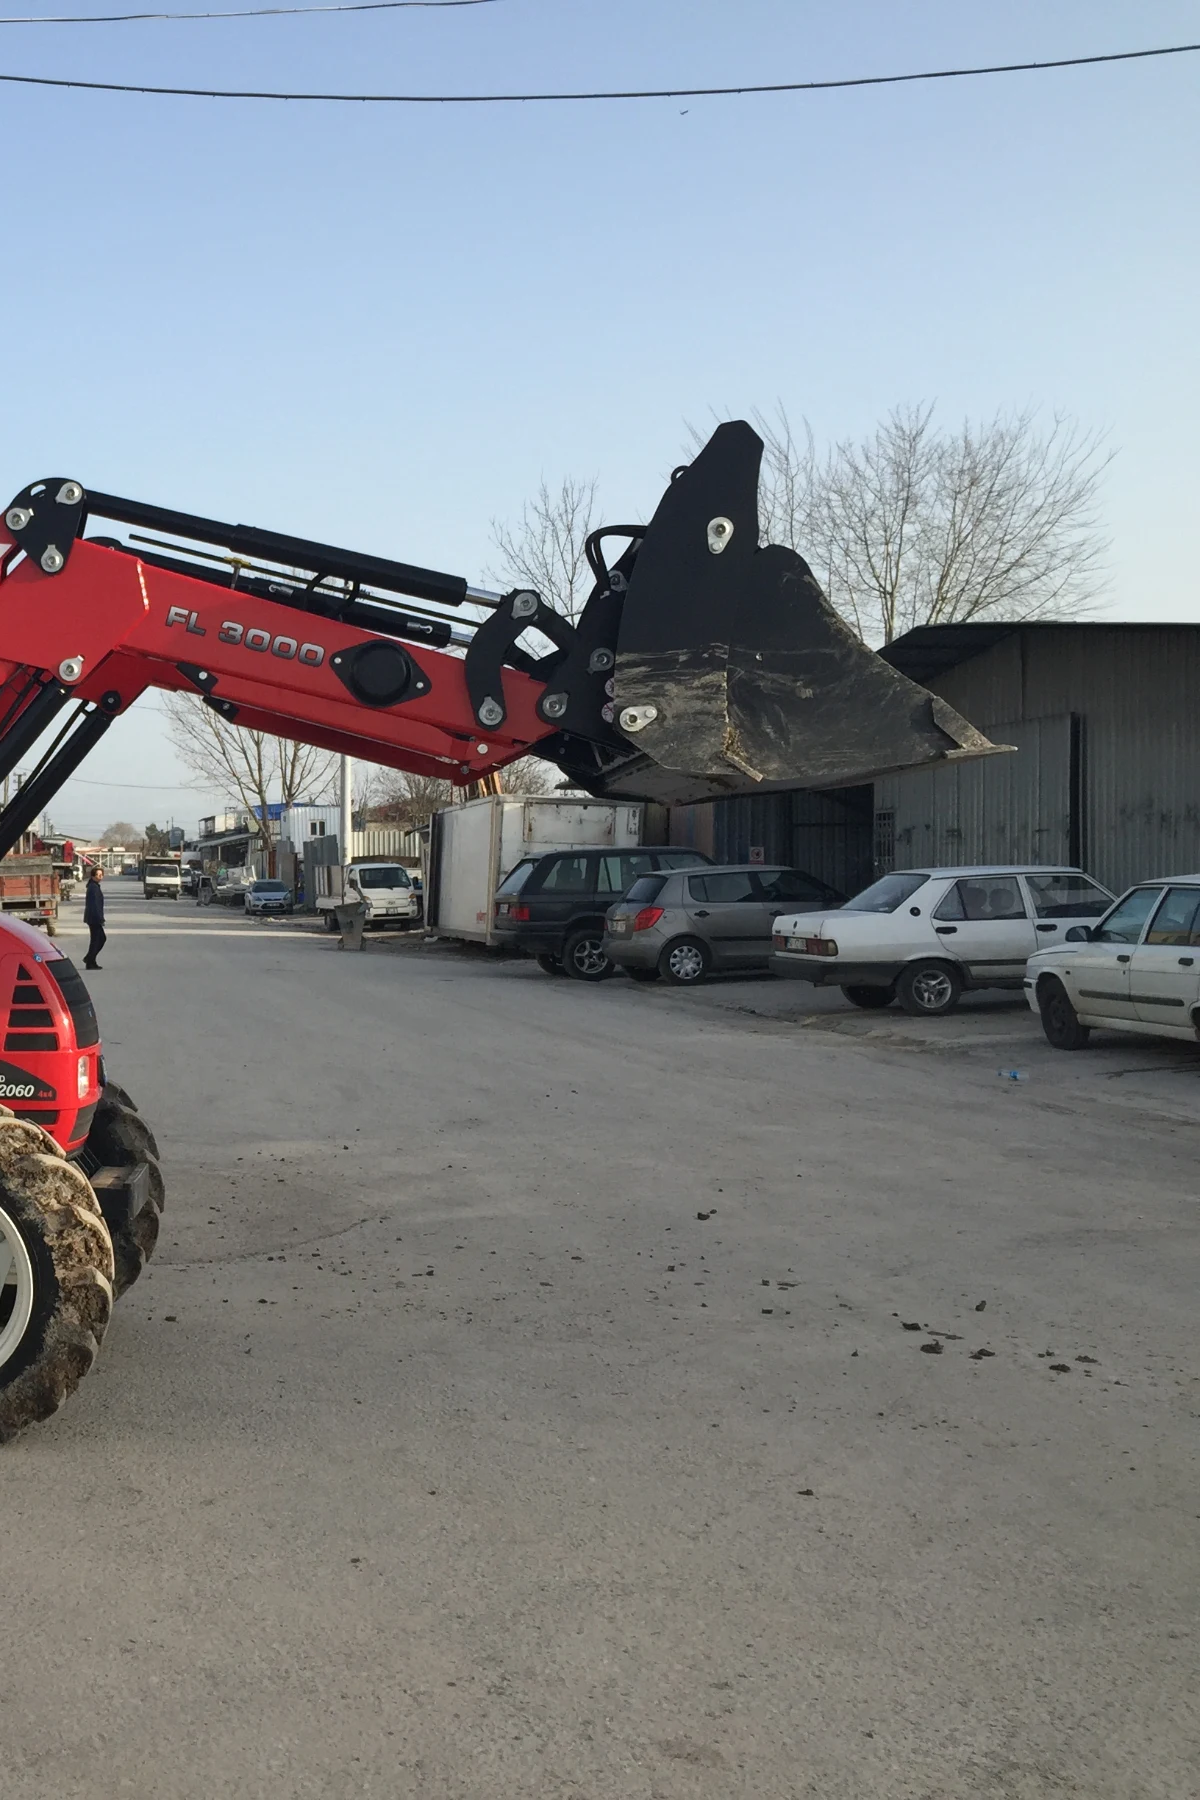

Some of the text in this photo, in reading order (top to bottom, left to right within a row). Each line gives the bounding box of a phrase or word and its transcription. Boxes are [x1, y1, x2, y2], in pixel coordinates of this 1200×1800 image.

[165, 605, 325, 667] FL 3000
[38, 1090, 53, 1098] 4x4
